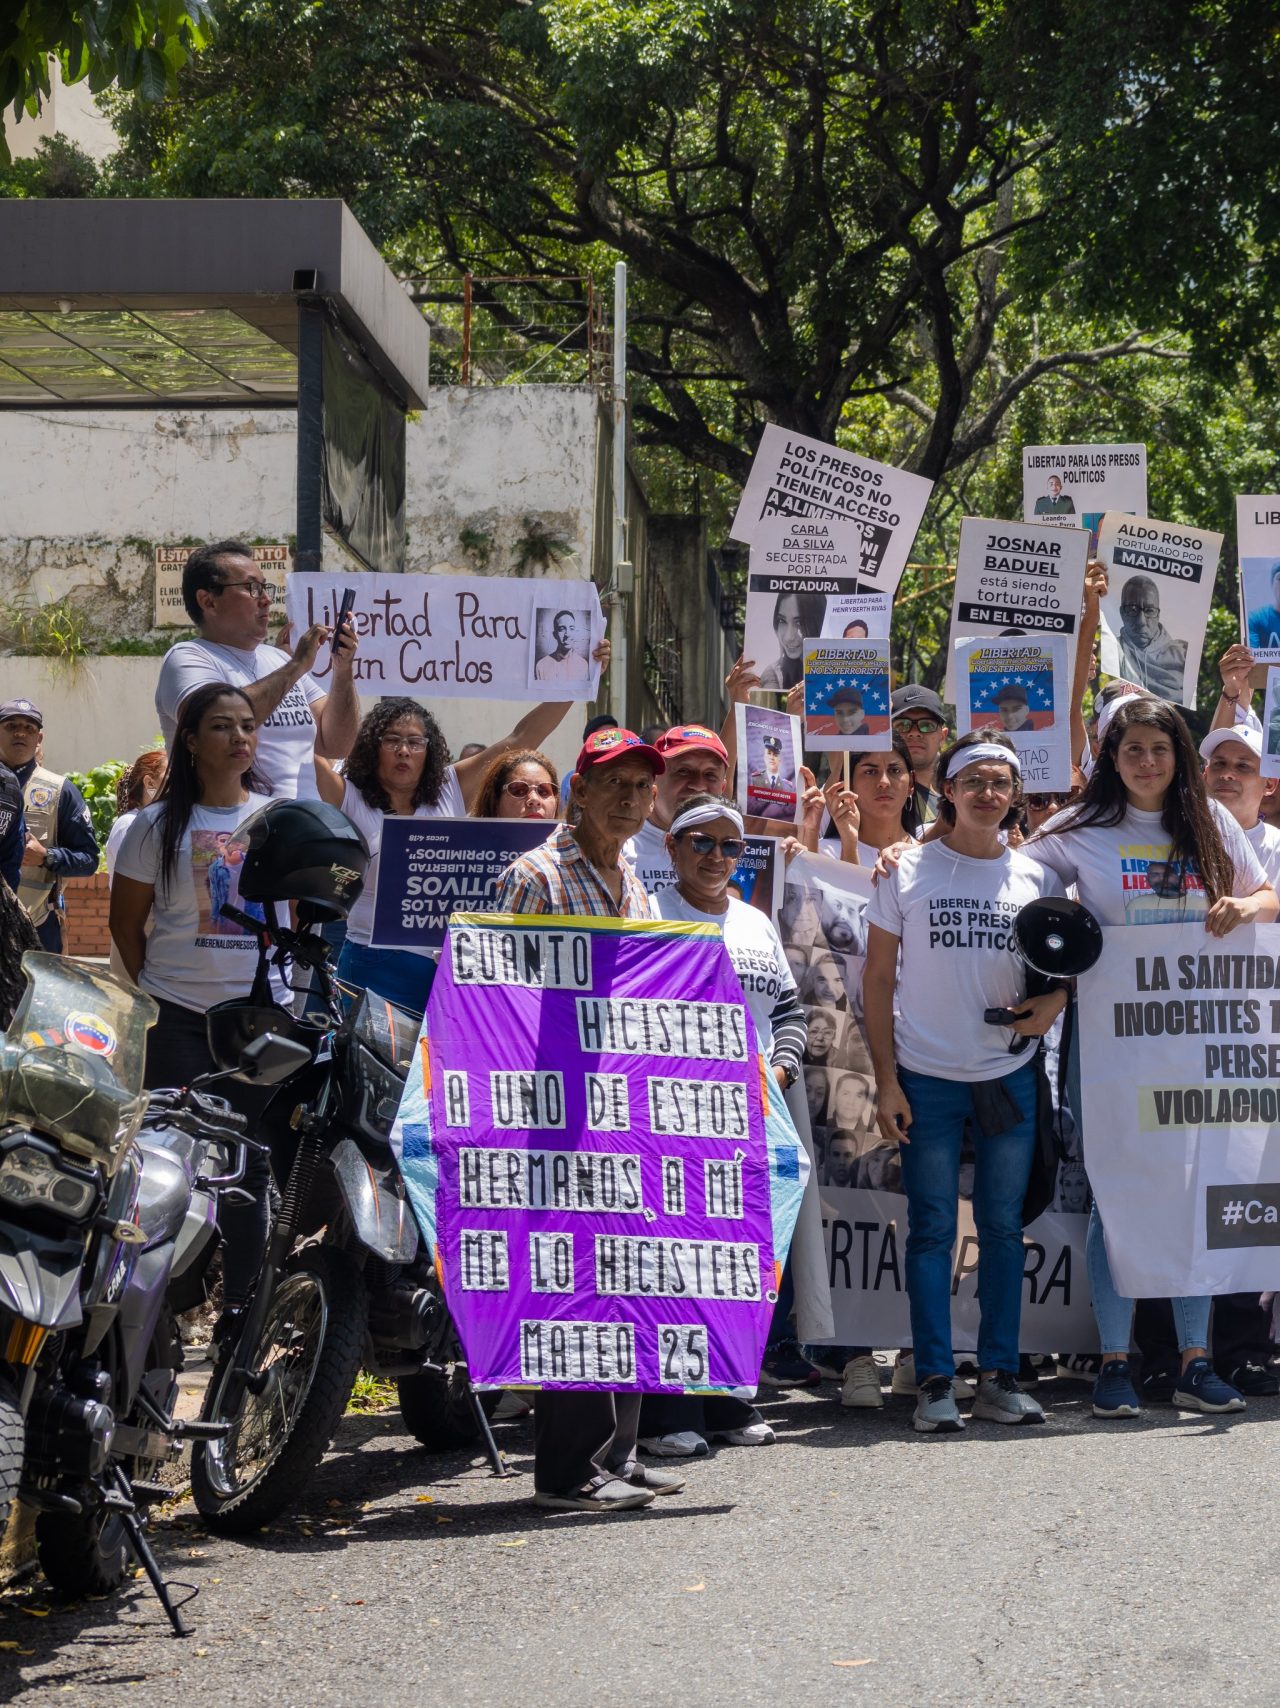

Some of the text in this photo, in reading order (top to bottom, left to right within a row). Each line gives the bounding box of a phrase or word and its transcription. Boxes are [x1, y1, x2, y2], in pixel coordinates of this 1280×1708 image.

[784, 442, 883, 487] LOS PRESOS
[1028, 453, 1140, 468] LIBERTAD PARA LOS PRESOS
[779, 457, 892, 507] POLÍTICOS NO
[1063, 468, 1106, 484] POLÍTICOS
[767, 490, 780, 505] A
[775, 472, 900, 527] TIENEN ACCESO
[791, 524, 829, 535] CARLA
[1117, 523, 1203, 550] ALDO ROSO
[783, 539, 834, 549] DA SILVA
[861, 541, 879, 557] NI
[986, 535, 1062, 556] JOSNAR
[1116, 537, 1204, 563] TORTURADO POR
[260, 561, 286, 570] HOTEL
[766, 553, 848, 565] SECUESTRADA
[985, 556, 1060, 576] BADUEL
[1121, 552, 1194, 578] MADURO
[788, 565, 828, 575] POR LA
[770, 580, 839, 592] DICTADURA
[980, 577, 1057, 593] está siendo
[977, 588, 1060, 609] torturado
[455, 591, 527, 640] Para
[970, 608, 1065, 629] EN EL RODEO
[399, 639, 493, 683] Carlos
[816, 649, 878, 660] LIBERTAD
[980, 647, 1041, 659] LIBERTAD
[809, 667, 823, 675] NO
[834, 667, 884, 675] TERRORISTA
[973, 664, 1048, 673] NO TERRORISTA
[426, 835, 449, 843] Lucas
[744, 845, 770, 857] Cariel
[408, 863, 465, 873] LIBERTAD
[468, 864, 483, 873] EN
[334, 877, 350, 885] CITY
[401, 899, 449, 912] A LOS
[929, 898, 991, 910] LIBEREN A
[929, 912, 962, 928] LOS
[457, 932, 588, 987] CUANTO
[1135, 956, 1170, 992] LA
[1113, 999, 1261, 1037] INOCENTES
[581, 1002, 745, 1061] HICISTEIS
[450, 1073, 746, 1137] A UNO DE ESTOS
[666, 1160, 682, 1213] A
[708, 1150, 744, 1217] MÍ
[465, 1233, 570, 1289] ME LO
[524, 1325, 706, 1381] MATEO 25
